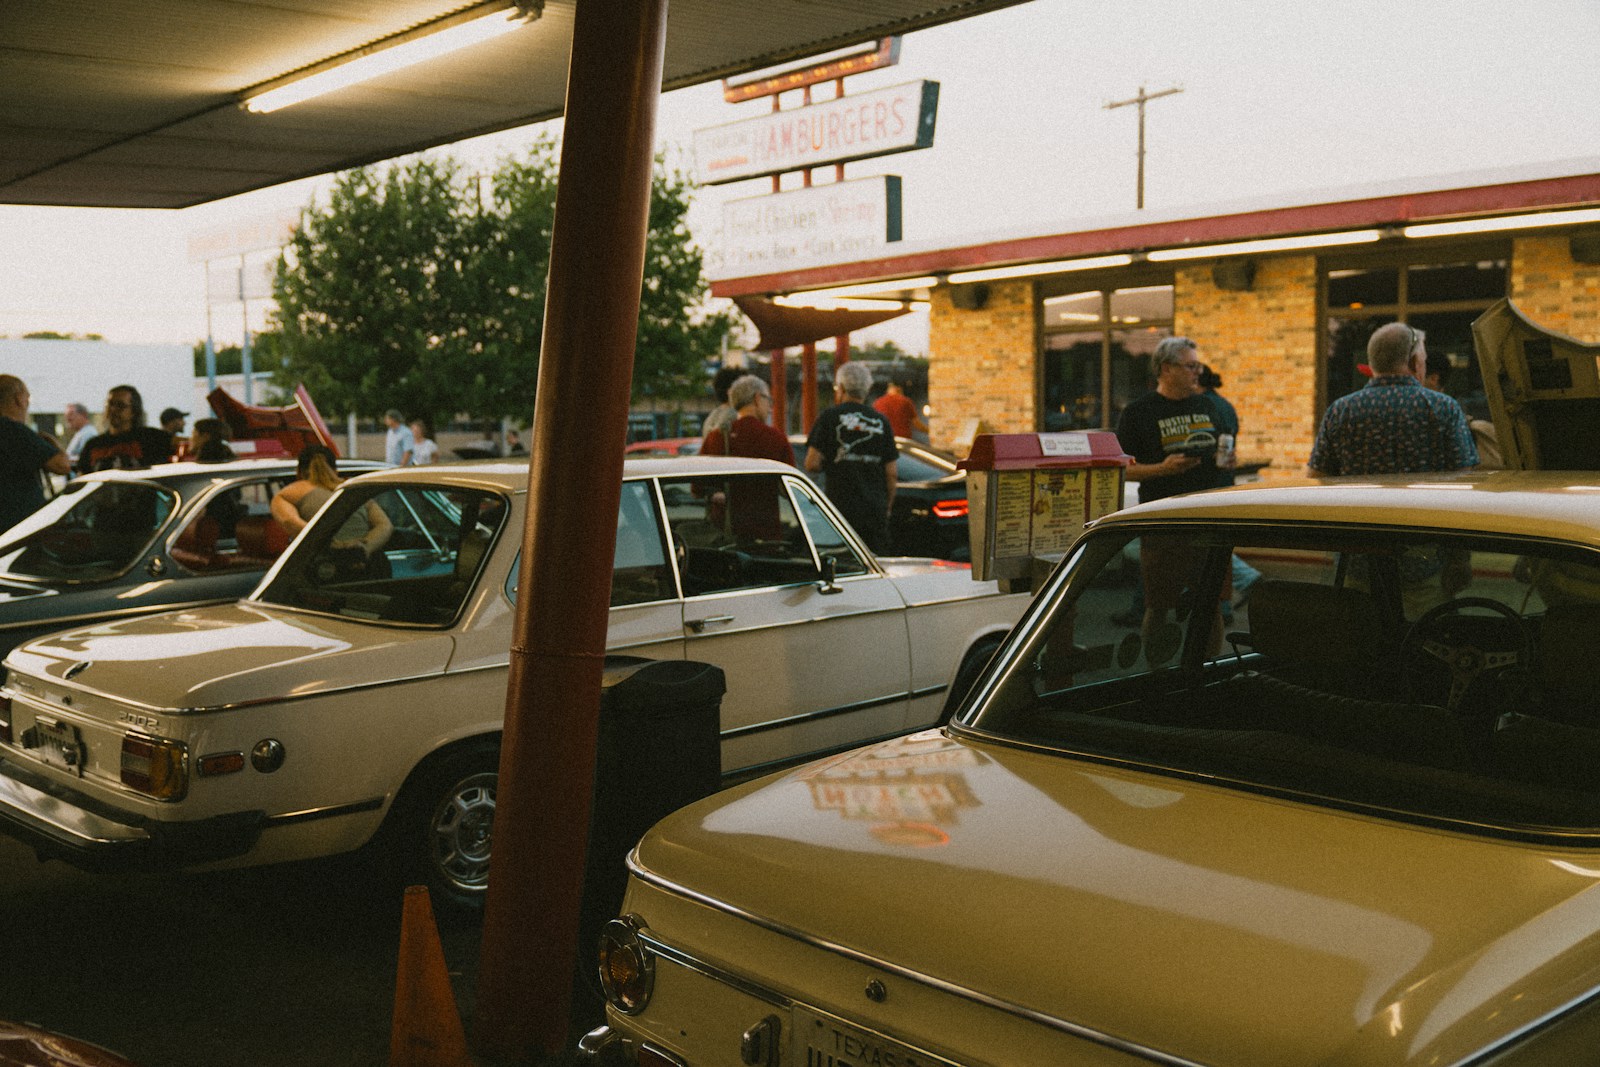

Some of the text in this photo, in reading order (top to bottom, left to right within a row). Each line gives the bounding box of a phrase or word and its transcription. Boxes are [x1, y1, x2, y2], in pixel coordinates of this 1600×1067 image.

[753, 97, 906, 163] HAMBURGERS
[1158, 414, 1191, 428] AUSTIN
[1161, 424, 1191, 437] LIMITS
[119, 711, 158, 729] 2002
[832, 1029, 896, 1067] TEXAS
